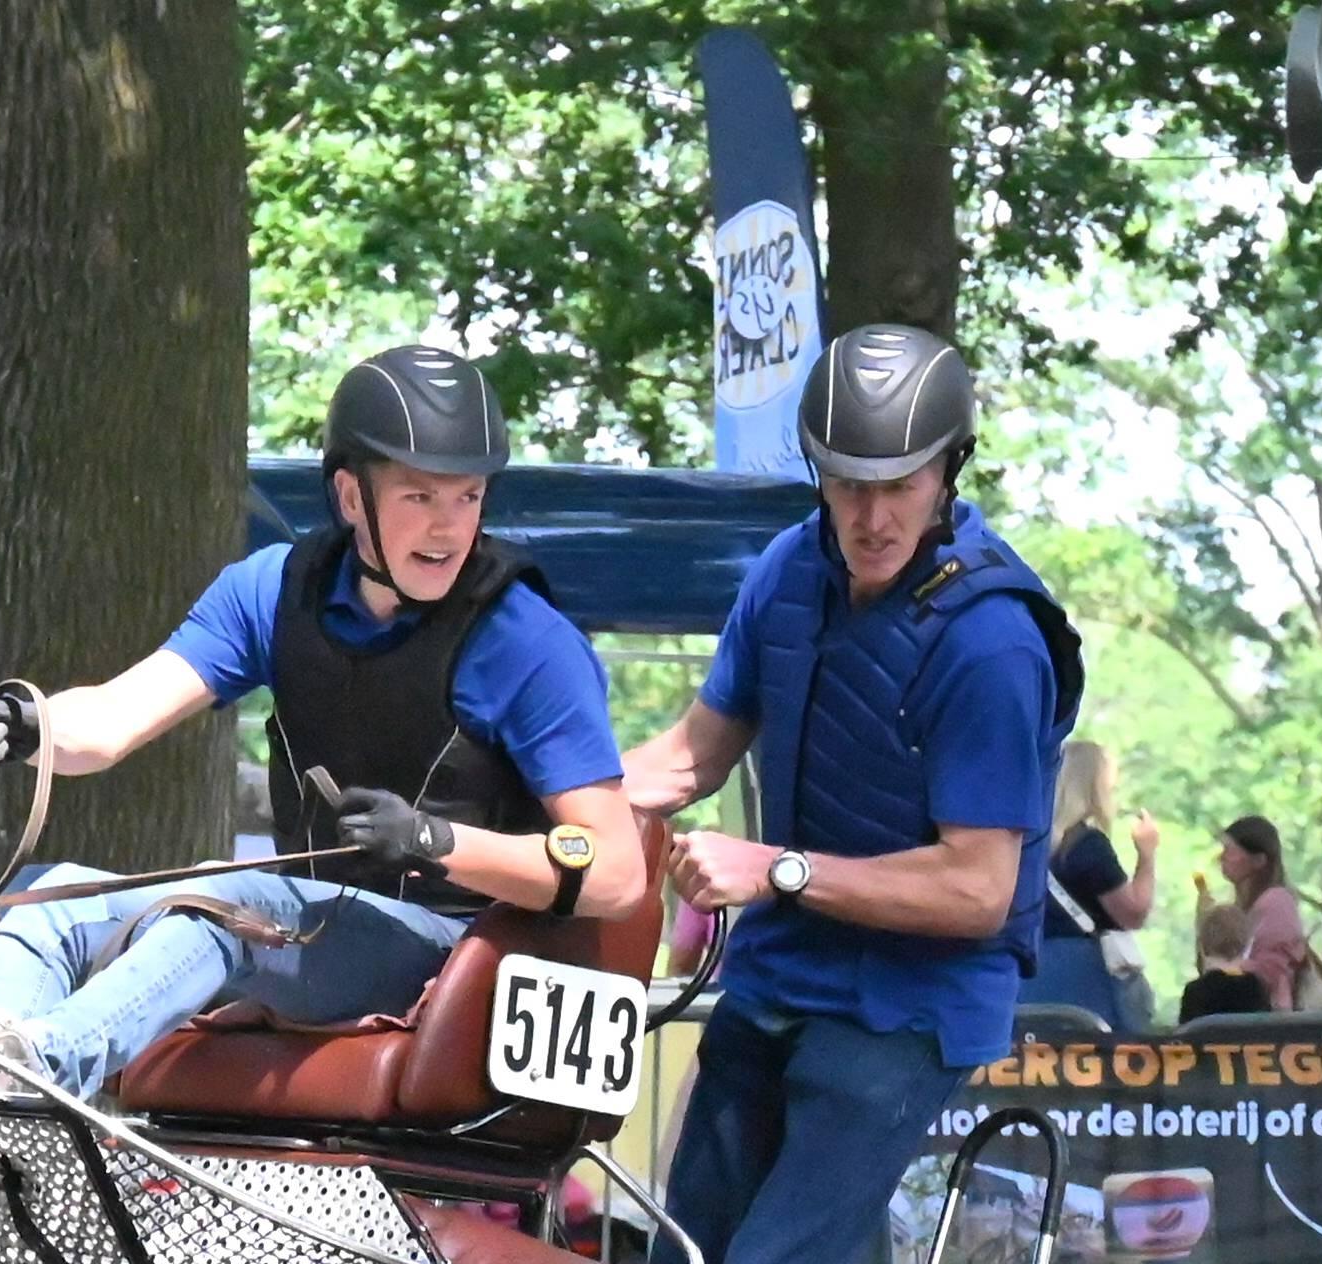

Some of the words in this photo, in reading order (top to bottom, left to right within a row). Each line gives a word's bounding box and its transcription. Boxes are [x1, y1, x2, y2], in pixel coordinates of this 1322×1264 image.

[503, 975, 638, 1092] 5143
[966, 1042, 1104, 1087] ERG
[1112, 1043, 1197, 1087] OP
[1087, 1103, 1136, 1136] de
[1142, 1101, 1259, 1145] loterij
[1265, 1103, 1307, 1136] of
